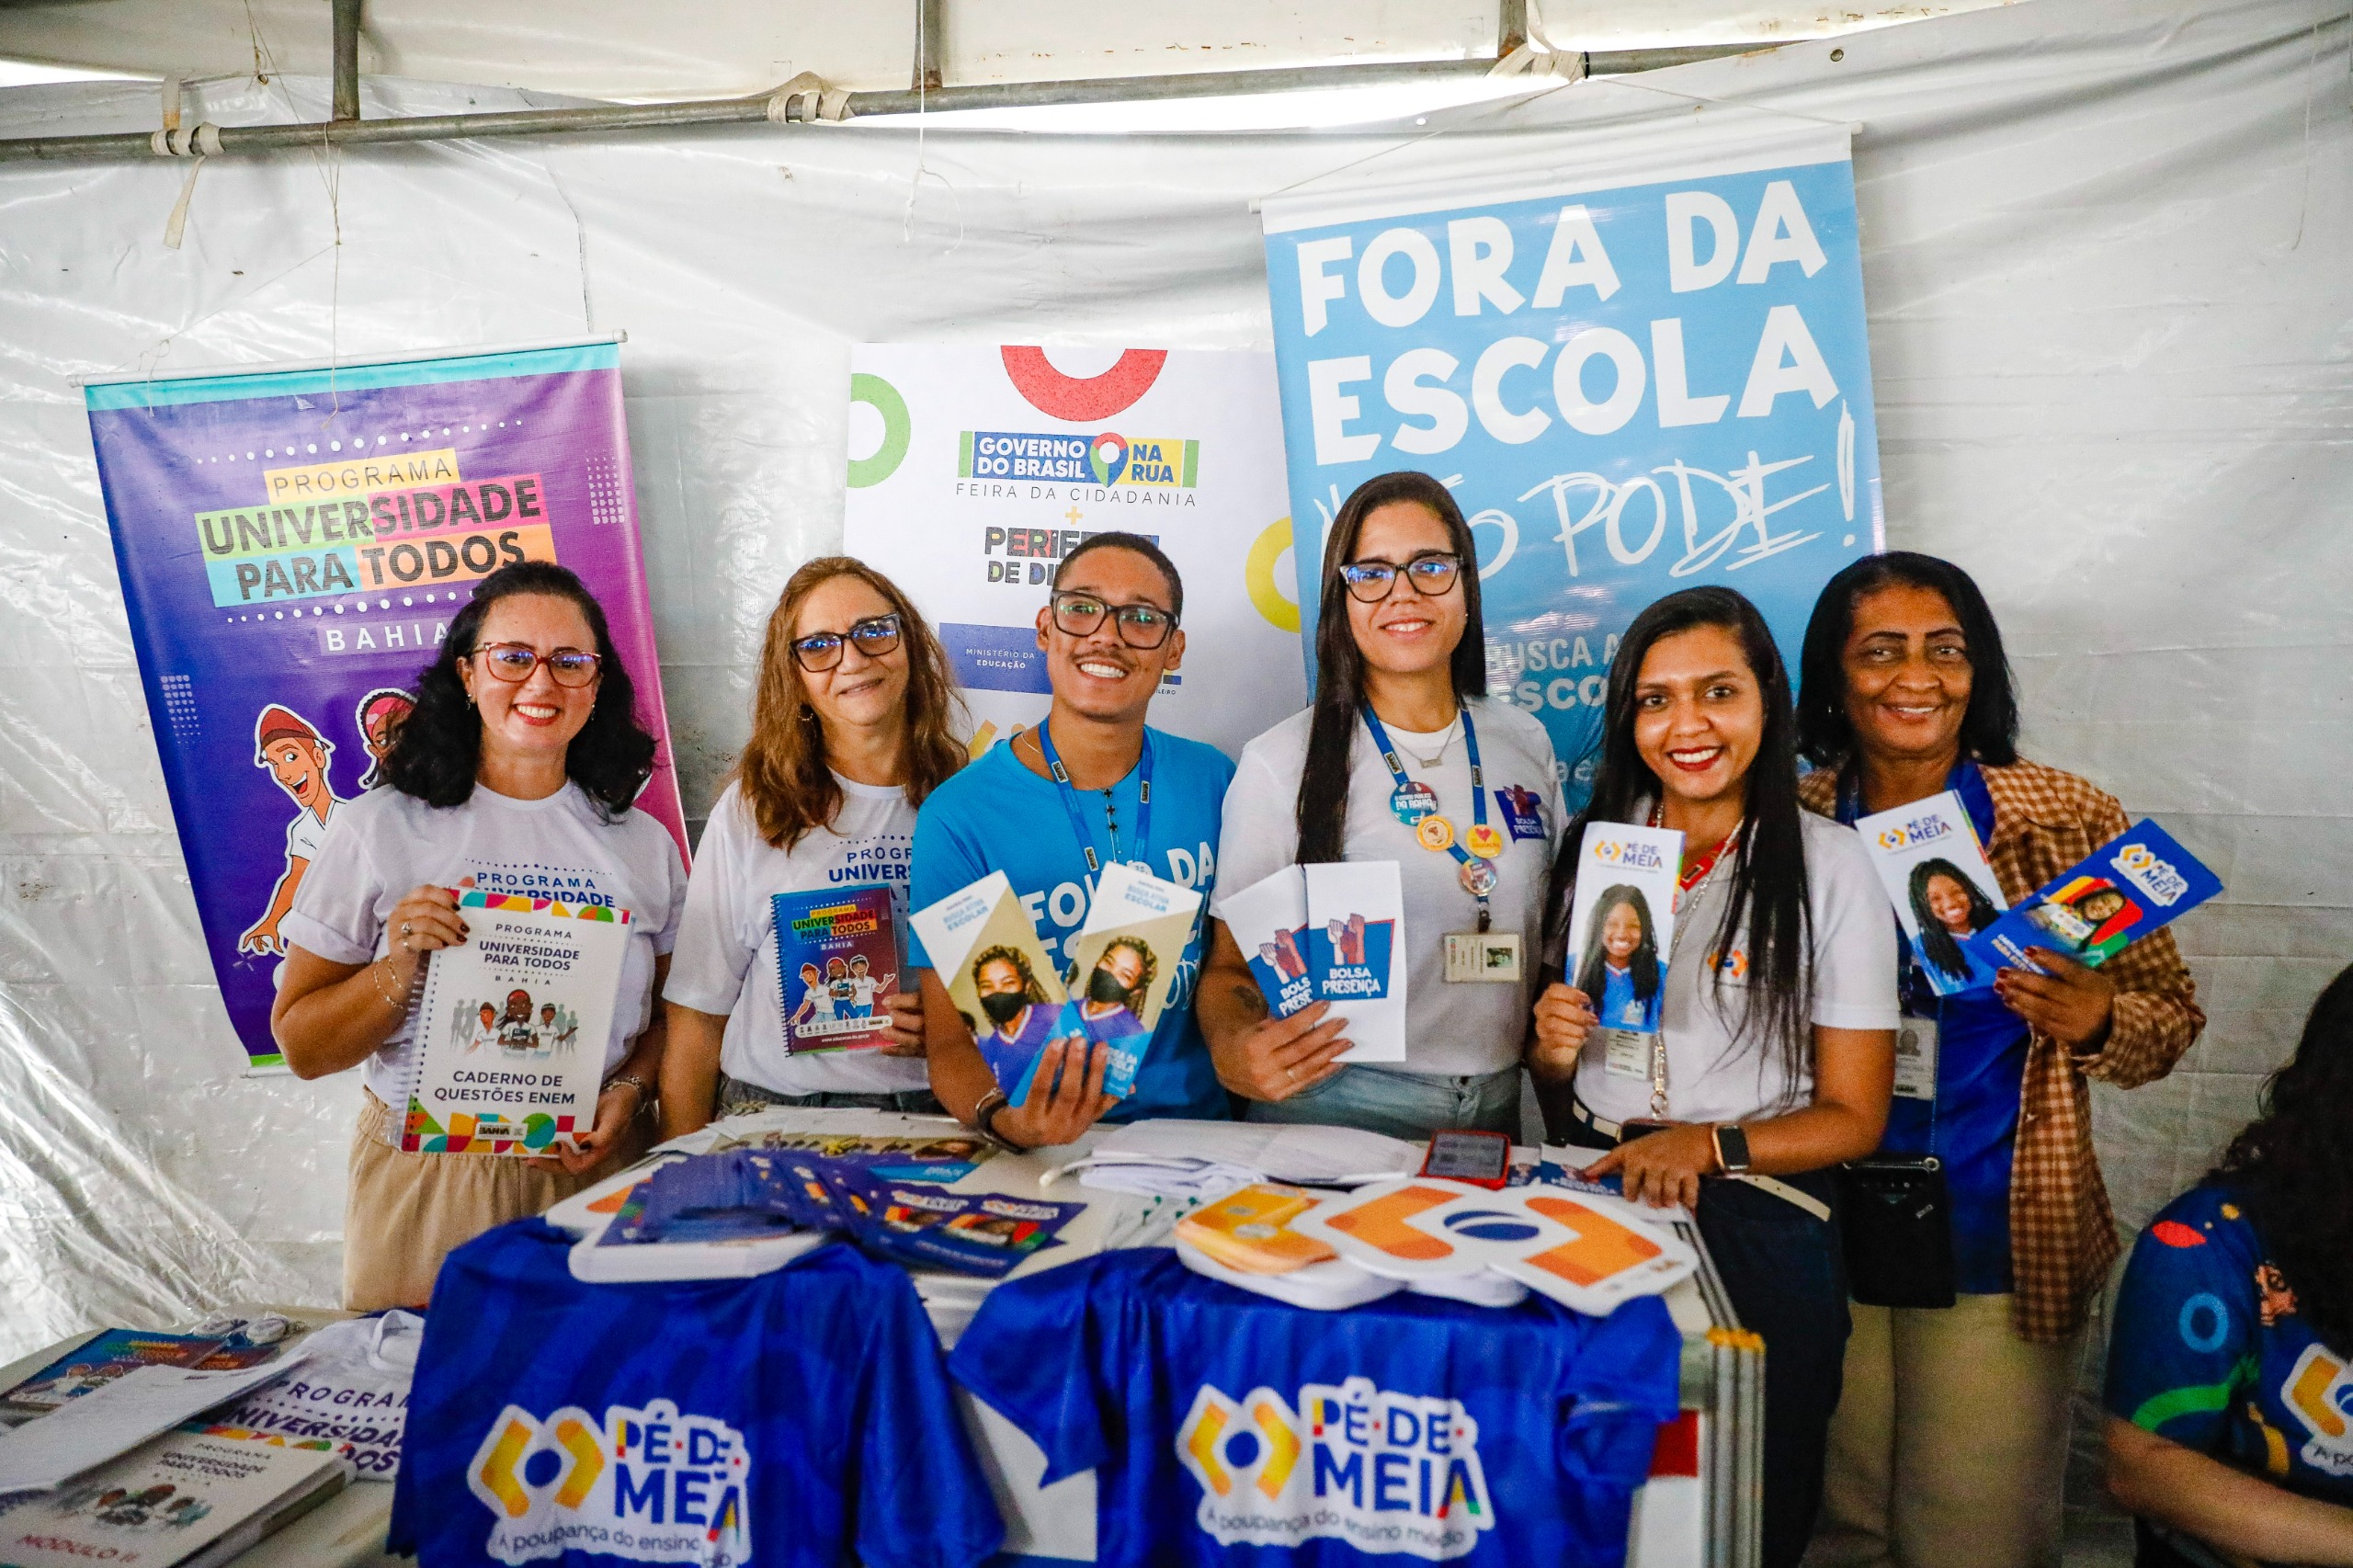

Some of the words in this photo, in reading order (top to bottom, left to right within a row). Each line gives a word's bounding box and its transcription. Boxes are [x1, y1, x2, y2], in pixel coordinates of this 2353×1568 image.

[1297, 204, 1621, 337] FORA
[1665, 179, 1827, 293] DA
[1308, 304, 1840, 466] ESCOLA
[980, 437, 1086, 459] GOVERNO
[1133, 444, 1163, 463] NA
[274, 457, 454, 496] PROGRAMA
[977, 457, 1009, 476] DO
[1014, 460, 1086, 479] BRASIL
[1131, 464, 1174, 483] RUA
[956, 483, 1017, 499] FEIRA
[1031, 486, 1056, 500] DA
[1071, 489, 1196, 507] CIDADANIA
[202, 480, 542, 555] UNIVERSIDADE
[236, 559, 355, 601] PARA
[361, 530, 526, 587] TODOS
[987, 561, 1021, 584] DE
[325, 621, 449, 652] BAHIA
[976, 659, 1027, 669] EDUCAÇÃO
[1023, 651, 1035, 659] DA
[1909, 821, 1952, 843] MEIA
[1166, 841, 1216, 889] DA
[1622, 852, 1663, 869] MEIA
[477, 872, 597, 889] PROGRAMA
[2140, 869, 2177, 902] MEIA
[793, 909, 875, 930] UNIVERSIDADE
[801, 927, 828, 939] PARA
[831, 921, 870, 936] TODOS
[495, 924, 573, 939] PROGRAMA
[480, 940, 580, 960] UNIVERSIDADE
[821, 941, 853, 950] BAHIA
[484, 953, 519, 966] PARA
[525, 957, 571, 971] TODOS
[494, 975, 551, 985] BAHIA
[1329, 966, 1372, 980] BOLSA
[1279, 976, 1312, 1000] BOLS
[1322, 979, 1381, 998] PRESENÇA
[453, 1071, 537, 1086] CADERNO
[542, 1075, 563, 1086] DE
[434, 1087, 524, 1103] QUESTÕES
[529, 1093, 575, 1105] ENEM
[162, 1451, 267, 1473] UNIVERSIDADE
[1313, 1441, 1483, 1519] MEIA
[1313, 1509, 1341, 1526] do
[512, 1525, 609, 1554] poupança
[612, 1528, 634, 1548] do
